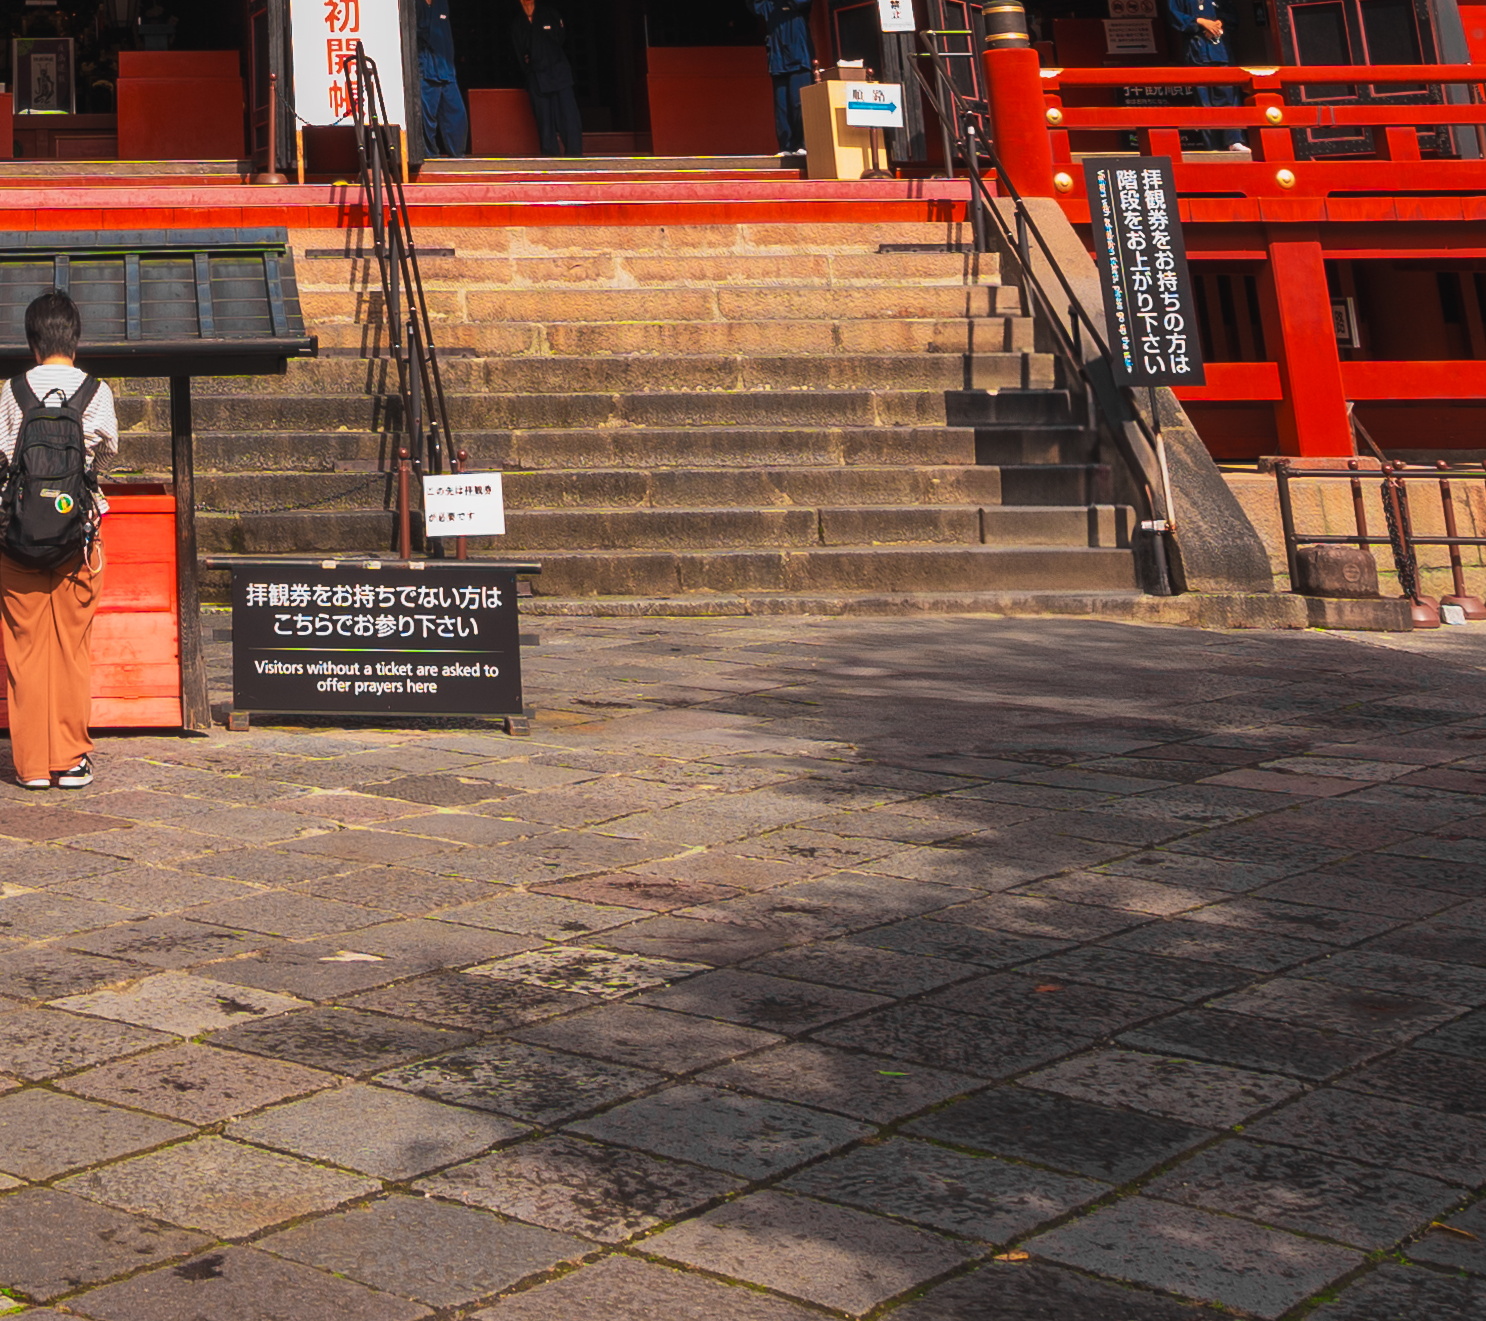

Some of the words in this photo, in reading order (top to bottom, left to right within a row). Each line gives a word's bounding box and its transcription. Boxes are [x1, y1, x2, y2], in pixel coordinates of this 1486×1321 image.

[1116, 169, 1166, 374] 階段をお上がり下さい
[1141, 169, 1191, 374] 拝観券をお持ちの方は
[427, 485, 492, 496] この先は拝観券
[428, 512, 475, 522] が必要です
[246, 582, 503, 610] 拝観券をお持ちでない方は
[273, 613, 479, 639] こちらでお参り下さい
[254, 660, 303, 675] Visitors
[307, 661, 360, 676] without
[364, 665, 373, 676] a
[375, 661, 413, 676] ticket
[416, 665, 439, 677] are
[442, 662, 481, 677] asked
[484, 664, 500, 677] to
[317, 678, 352, 693] offer
[355, 681, 404, 696] prayers
[407, 679, 438, 693] here
